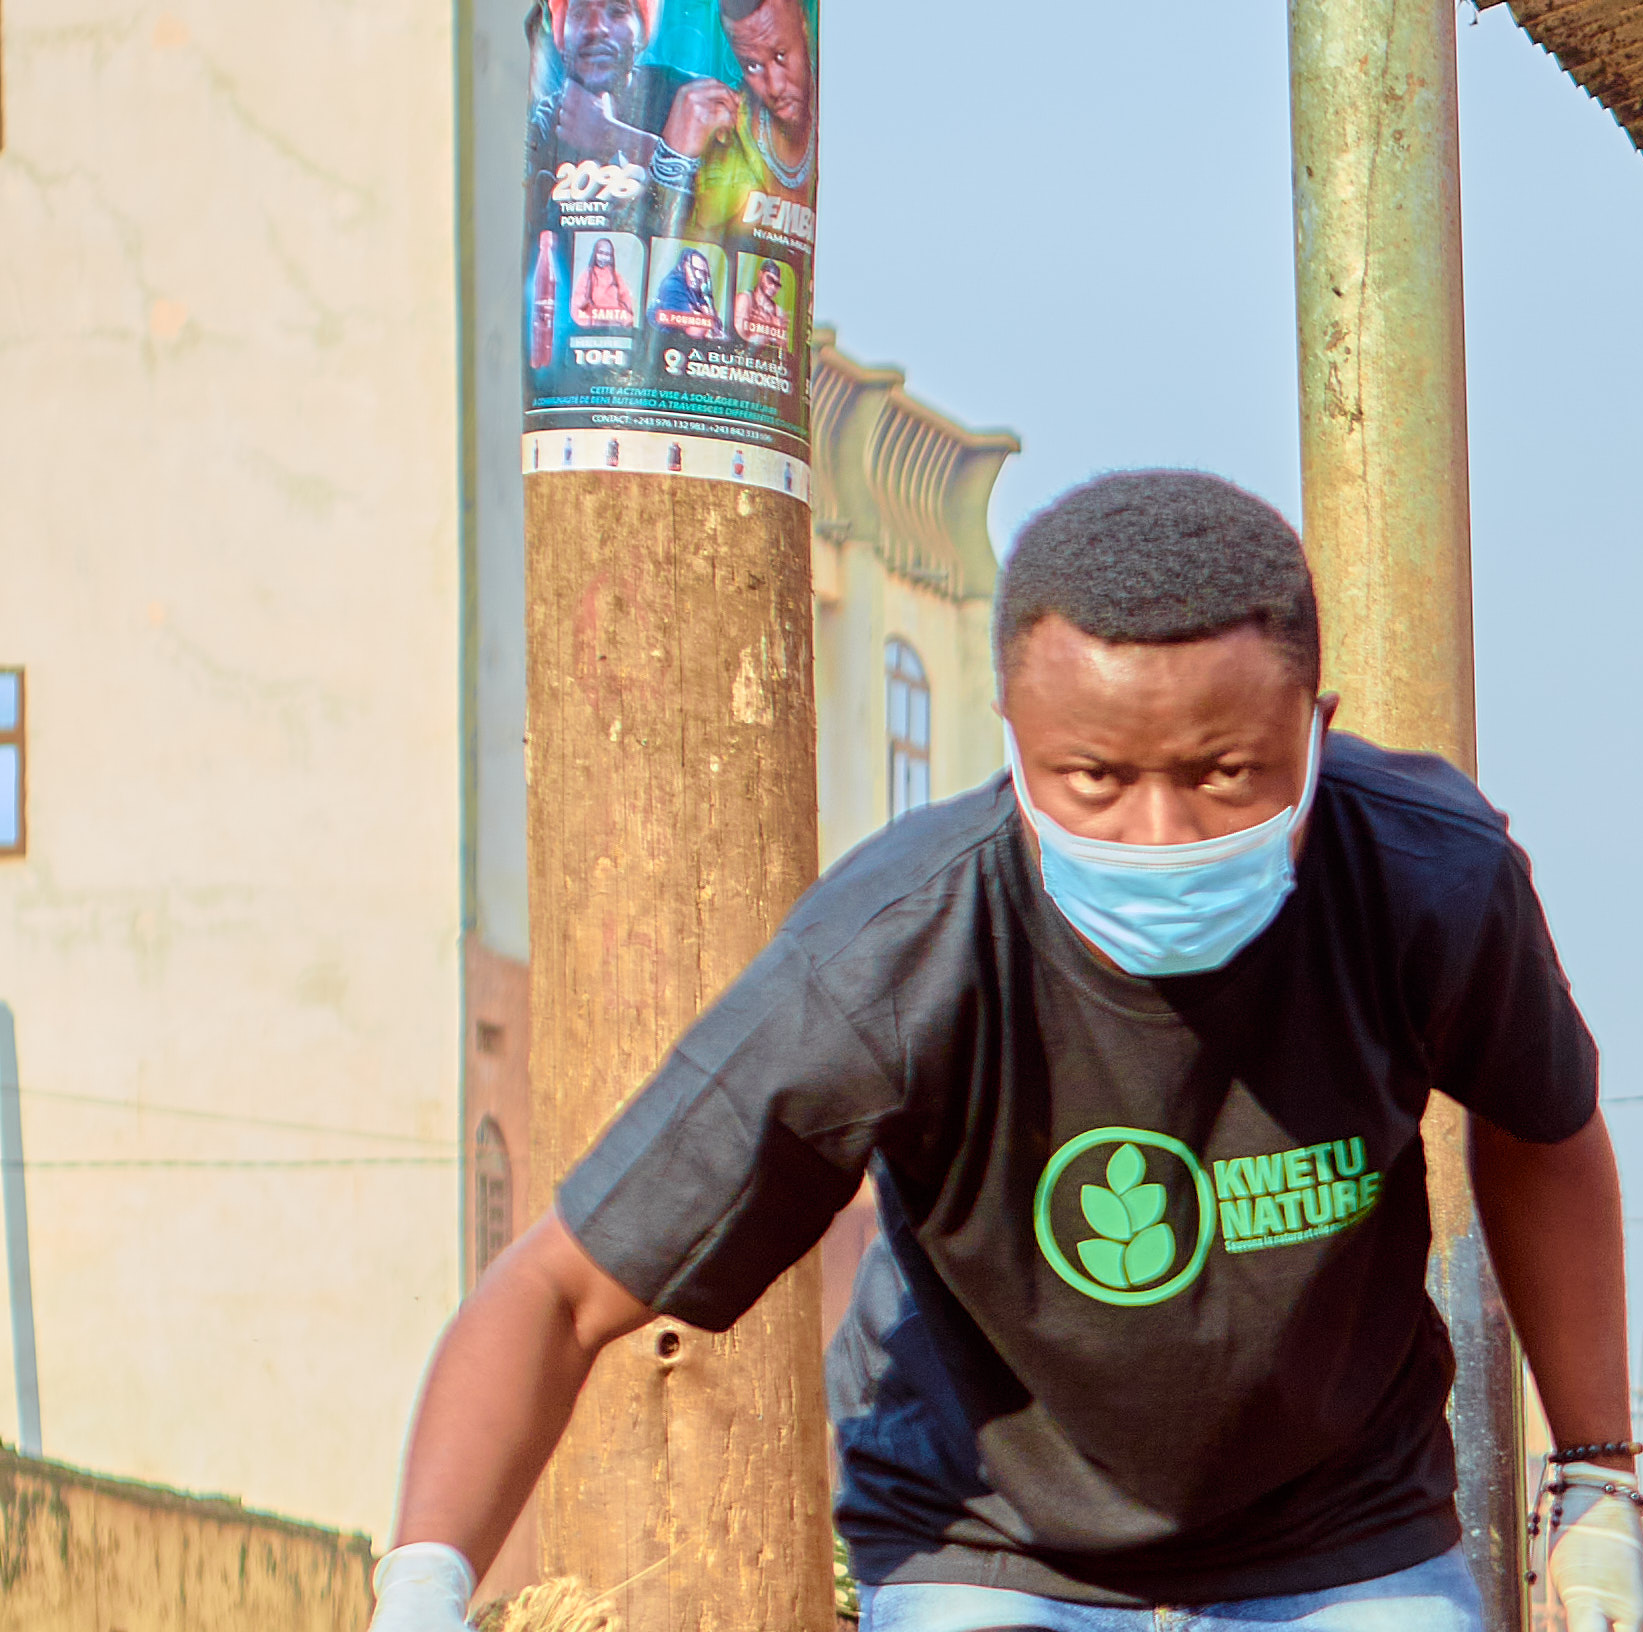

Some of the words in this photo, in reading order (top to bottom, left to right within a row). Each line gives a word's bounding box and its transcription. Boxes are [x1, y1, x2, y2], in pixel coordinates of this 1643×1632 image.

[560, 201, 609, 213] TWENTY
[742, 191, 813, 241] DEMB
[560, 215, 606, 227] POWER
[592, 308, 628, 320] SANTA
[574, 349, 627, 365] 10H
[708, 351, 788, 377] BUTEMBO
[686, 361, 728, 381] STADE
[1213, 1136, 1366, 1200] KWETU
[1219, 1171, 1384, 1240] NATURE
